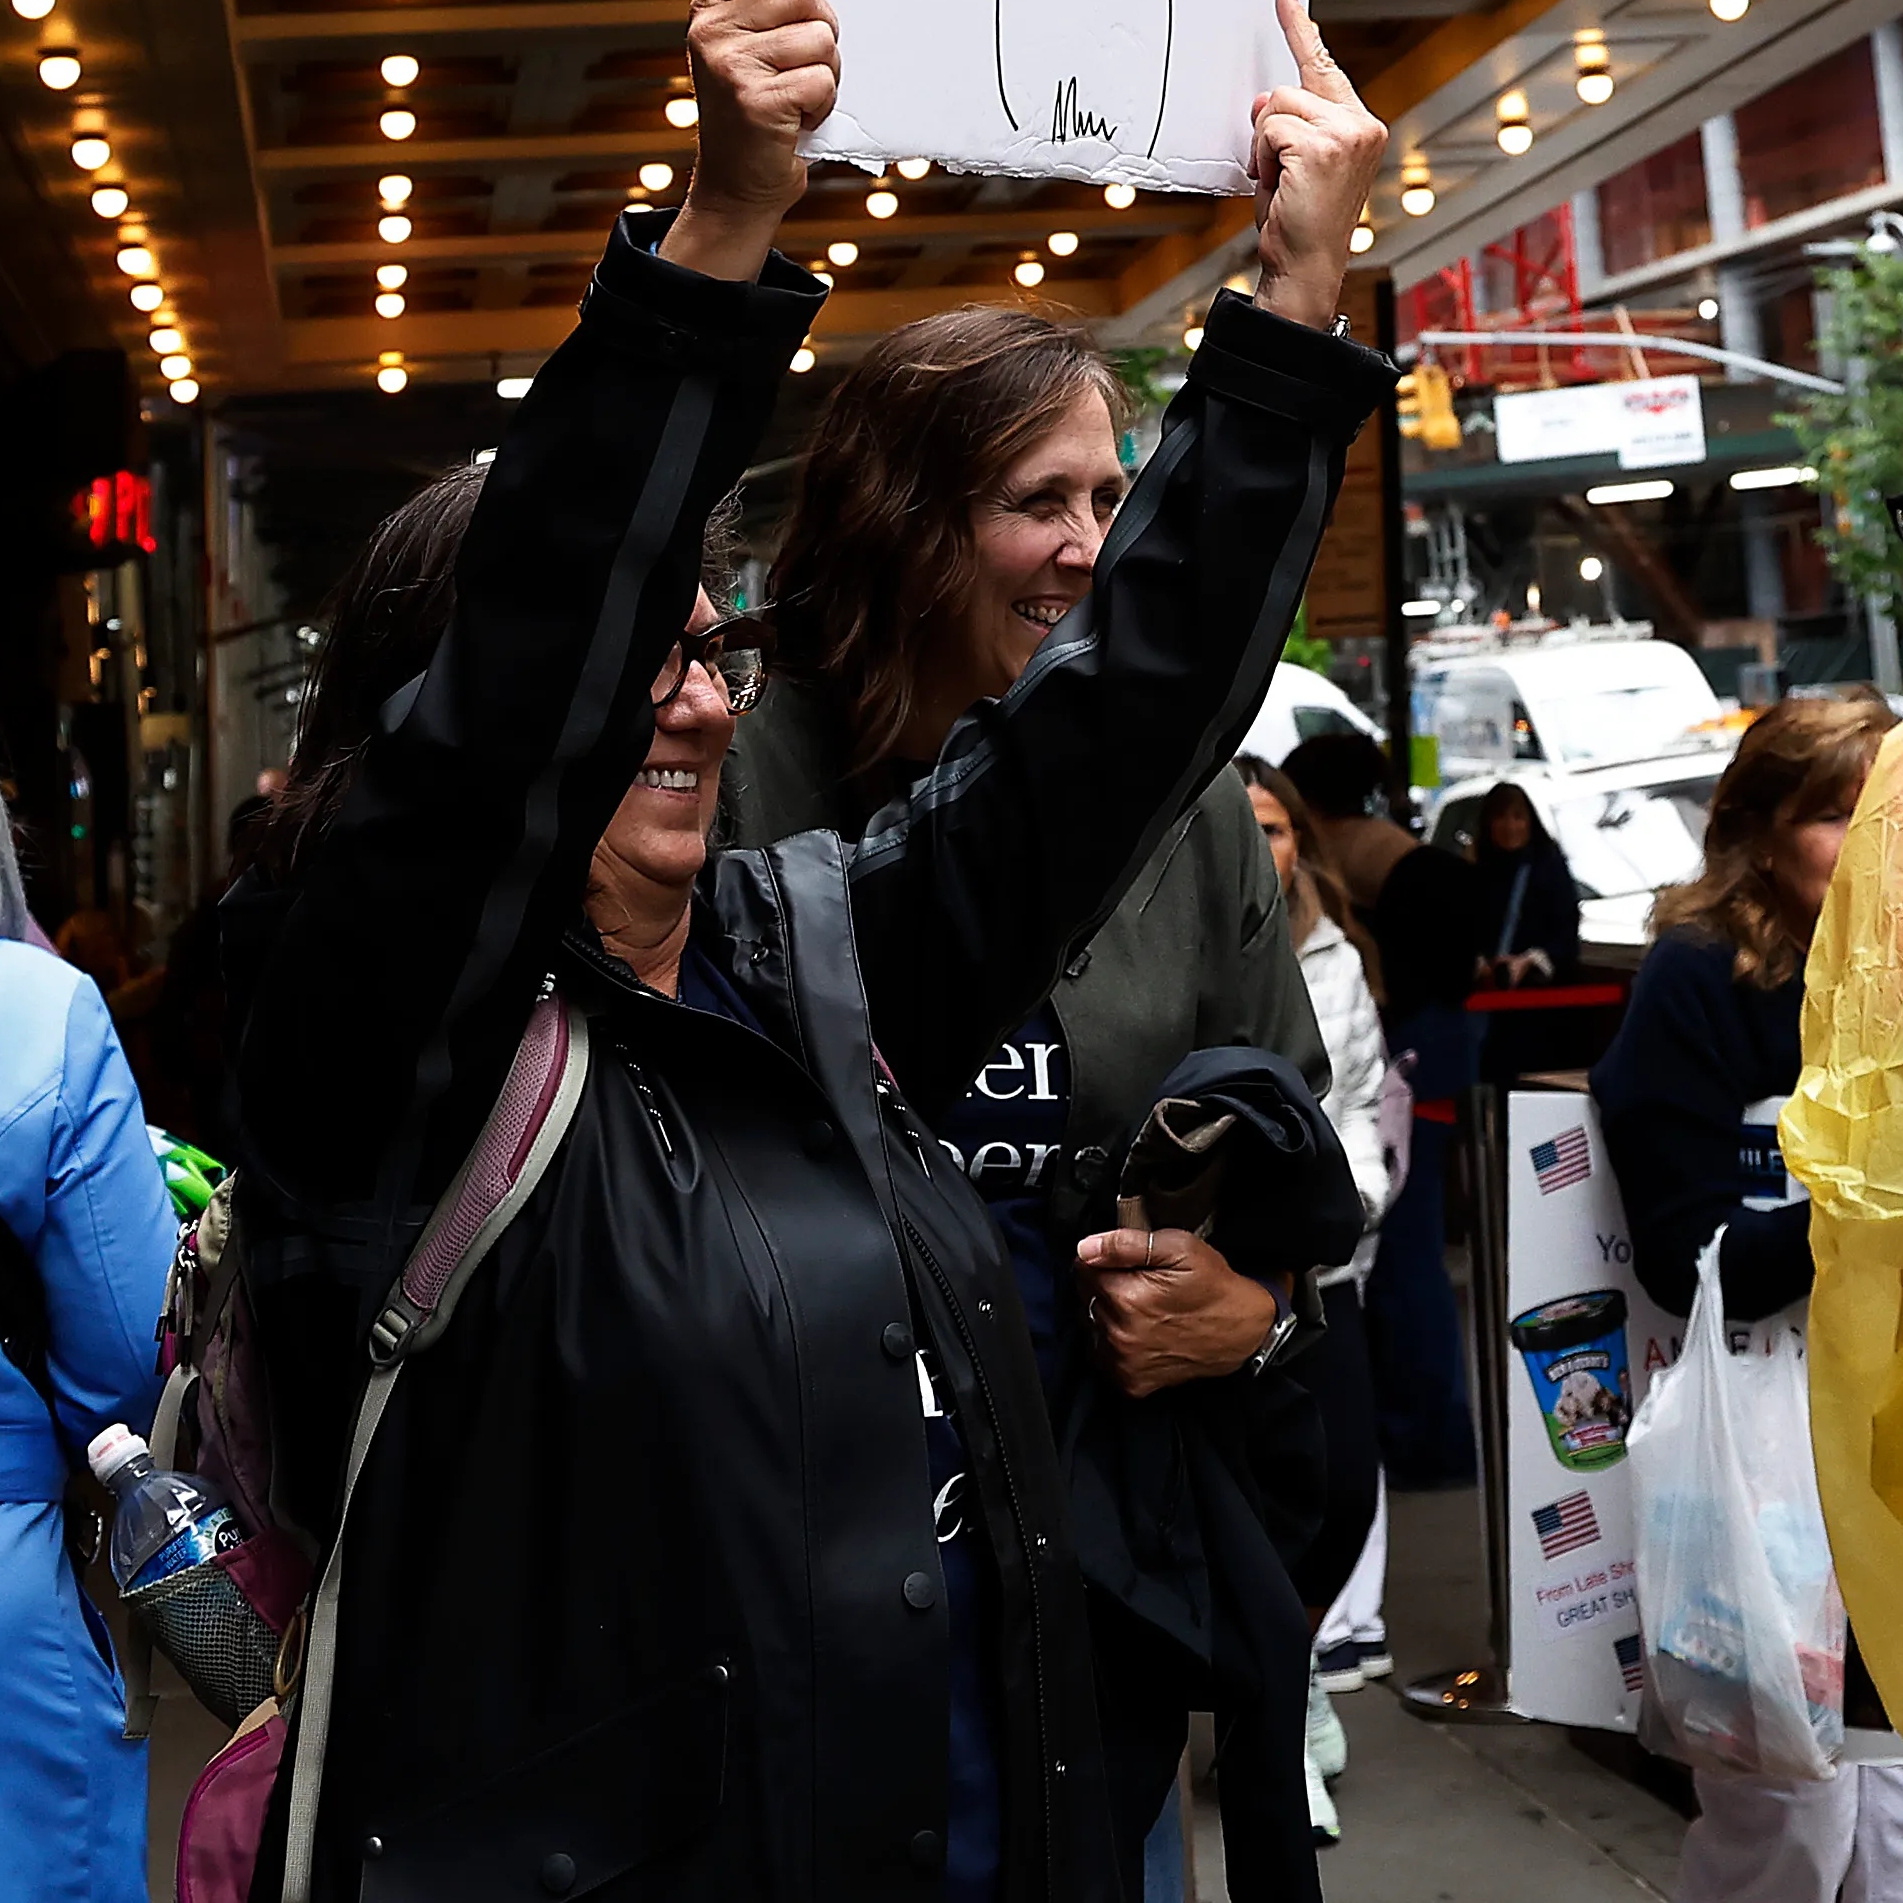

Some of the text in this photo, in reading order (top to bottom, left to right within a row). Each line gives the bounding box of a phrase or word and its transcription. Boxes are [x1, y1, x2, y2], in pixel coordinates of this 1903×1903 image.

[156, 1535, 188, 1562] PURIFIED
[164, 1547, 188, 1570] WATER
[1535, 1583, 1573, 1606] From
[1573, 1570, 1608, 1592] Late
[1555, 1596, 1609, 1629] GREAT
